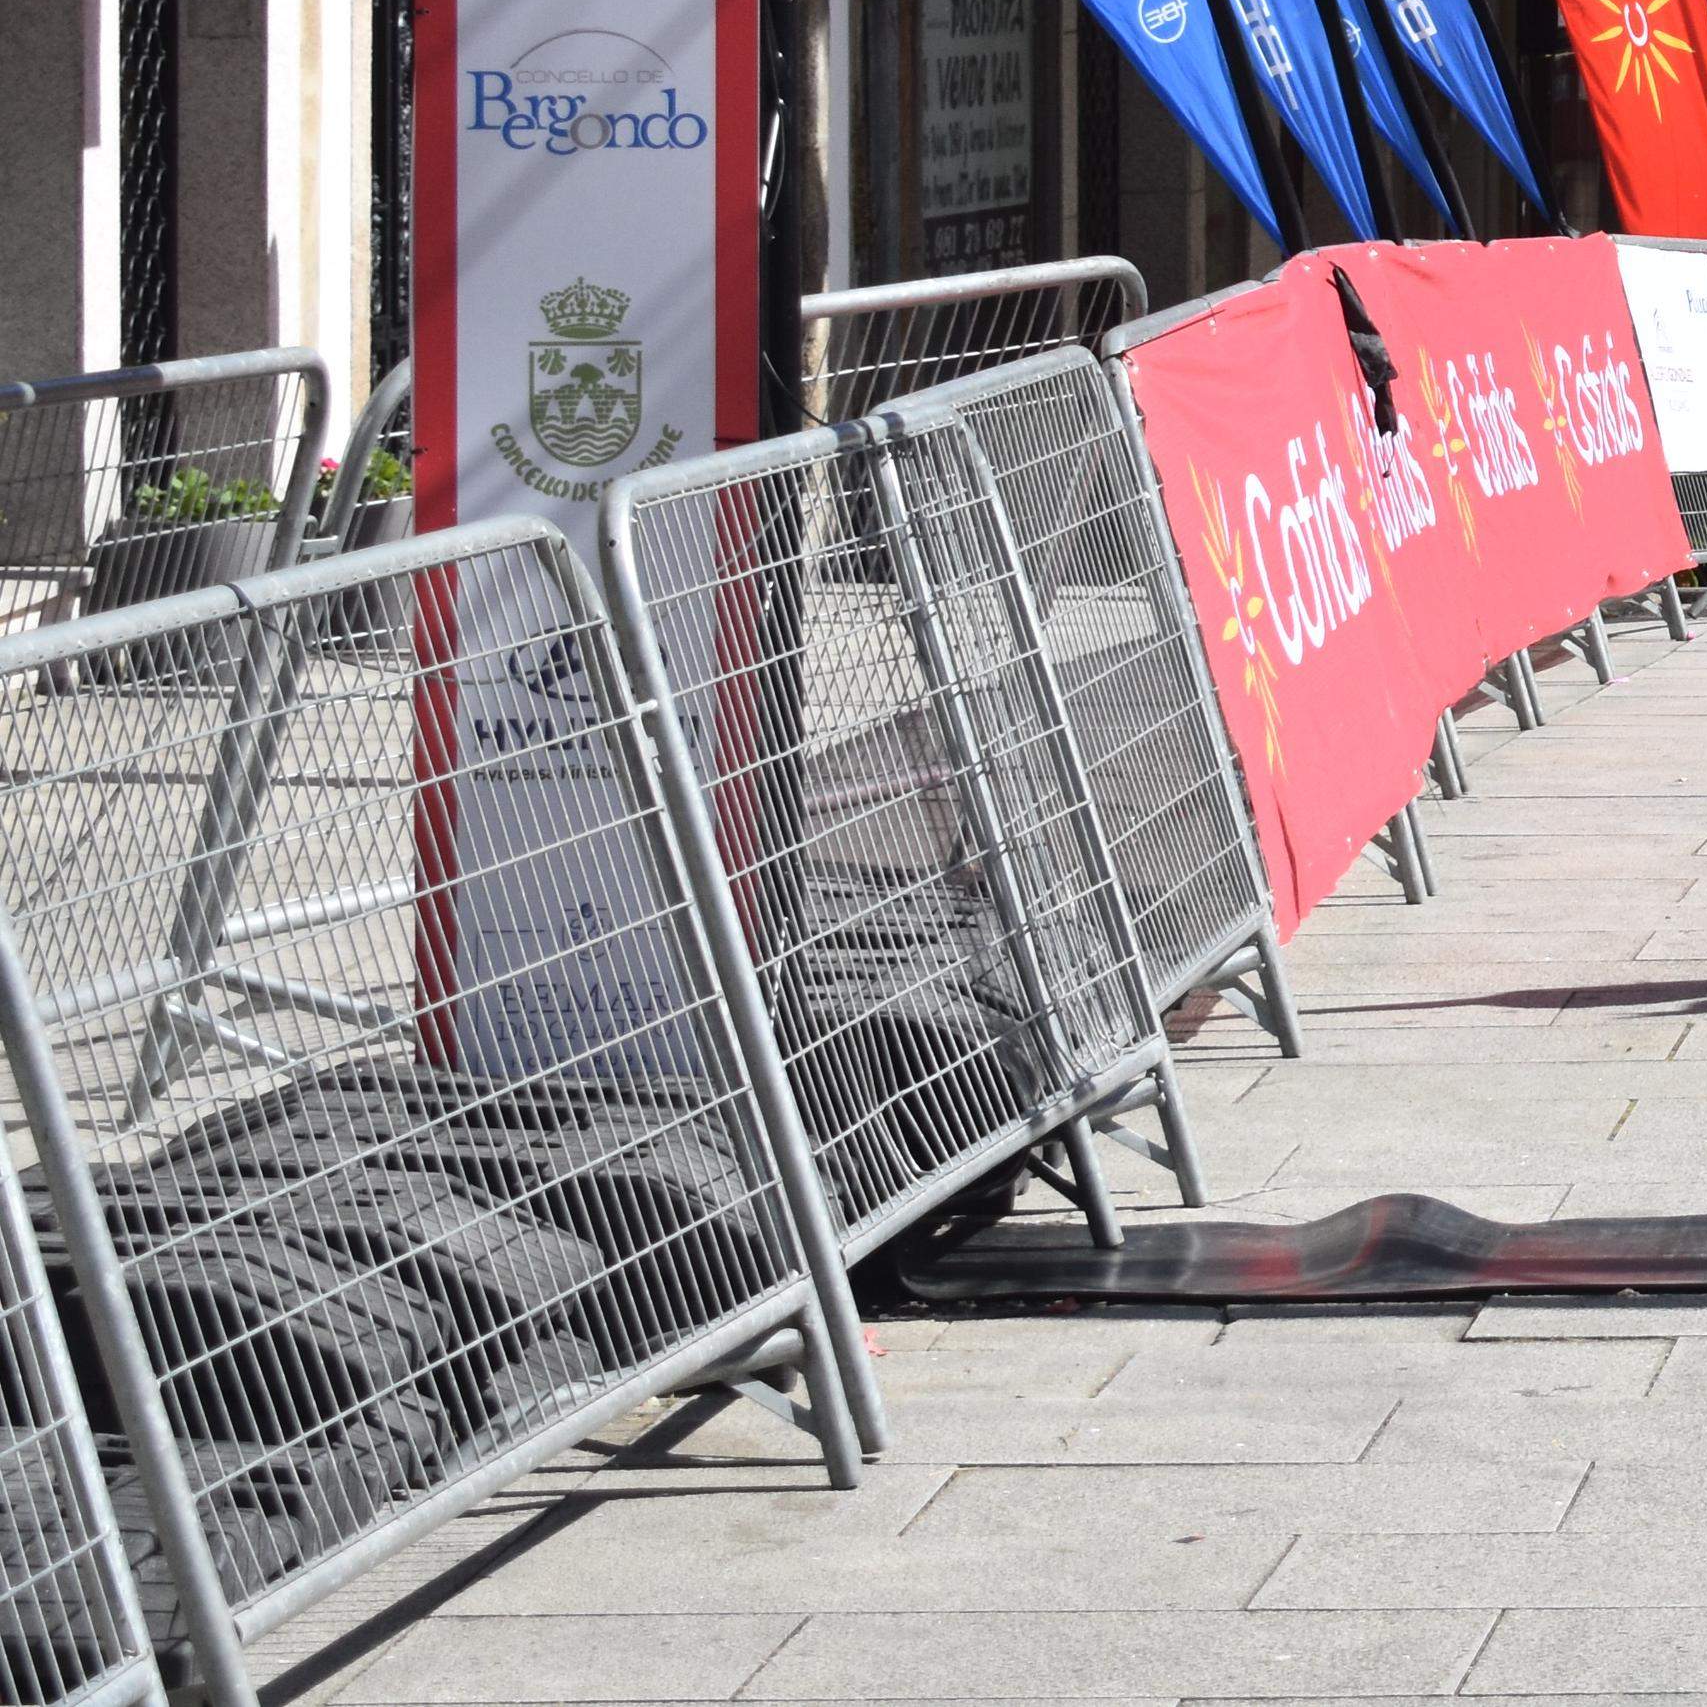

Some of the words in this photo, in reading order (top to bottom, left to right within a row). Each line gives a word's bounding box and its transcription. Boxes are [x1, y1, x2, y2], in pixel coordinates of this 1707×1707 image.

[467, 70, 707, 155] Bergondo
[516, 69, 627, 84] CONCELLO
[636, 69, 664, 84] DE
[1448, 350, 1540, 498] Cofidis
[1555, 330, 1644, 467] Cofidis
[491, 423, 571, 498] CONCELLO
[1244, 420, 1374, 666] Cofidis
[499, 981, 675, 1014] BEMAR
